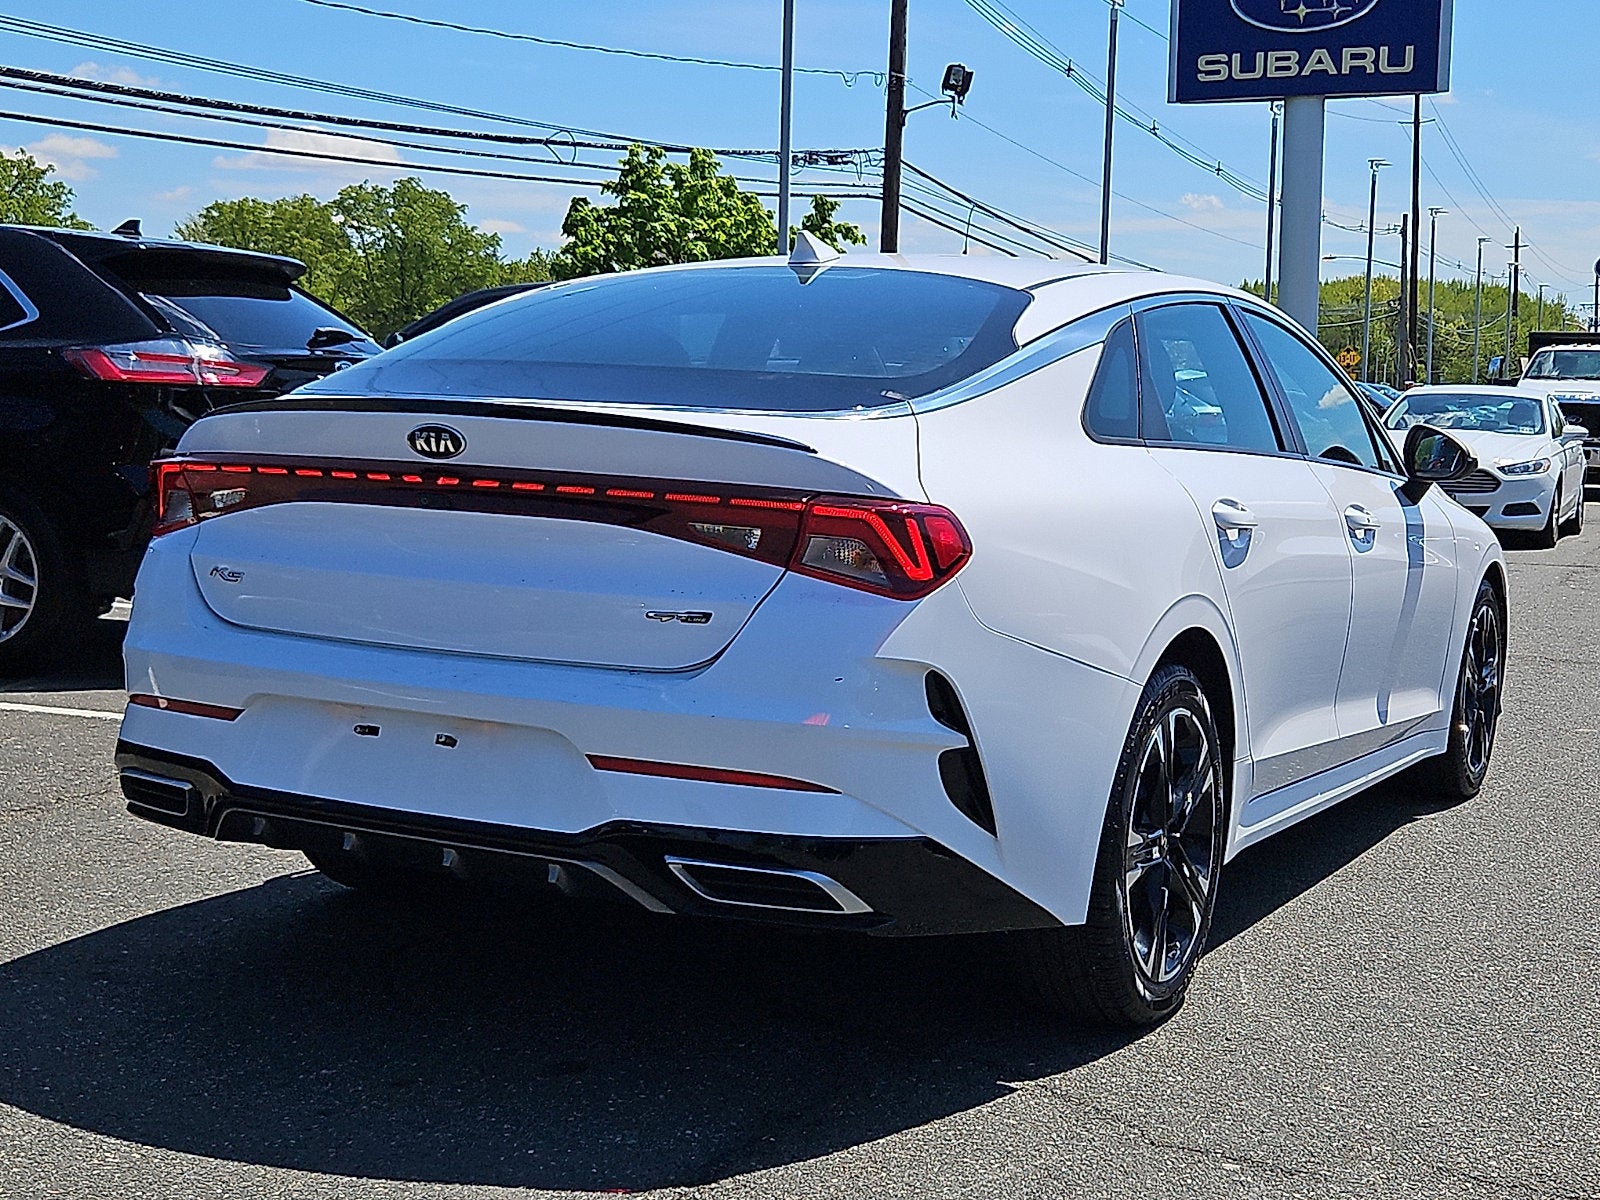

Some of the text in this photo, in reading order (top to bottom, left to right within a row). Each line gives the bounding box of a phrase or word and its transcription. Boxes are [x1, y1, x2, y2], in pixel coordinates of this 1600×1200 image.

[1197, 45, 1415, 82] SUBARU
[415, 431, 456, 453] KIA
[209, 566, 245, 583] K5
